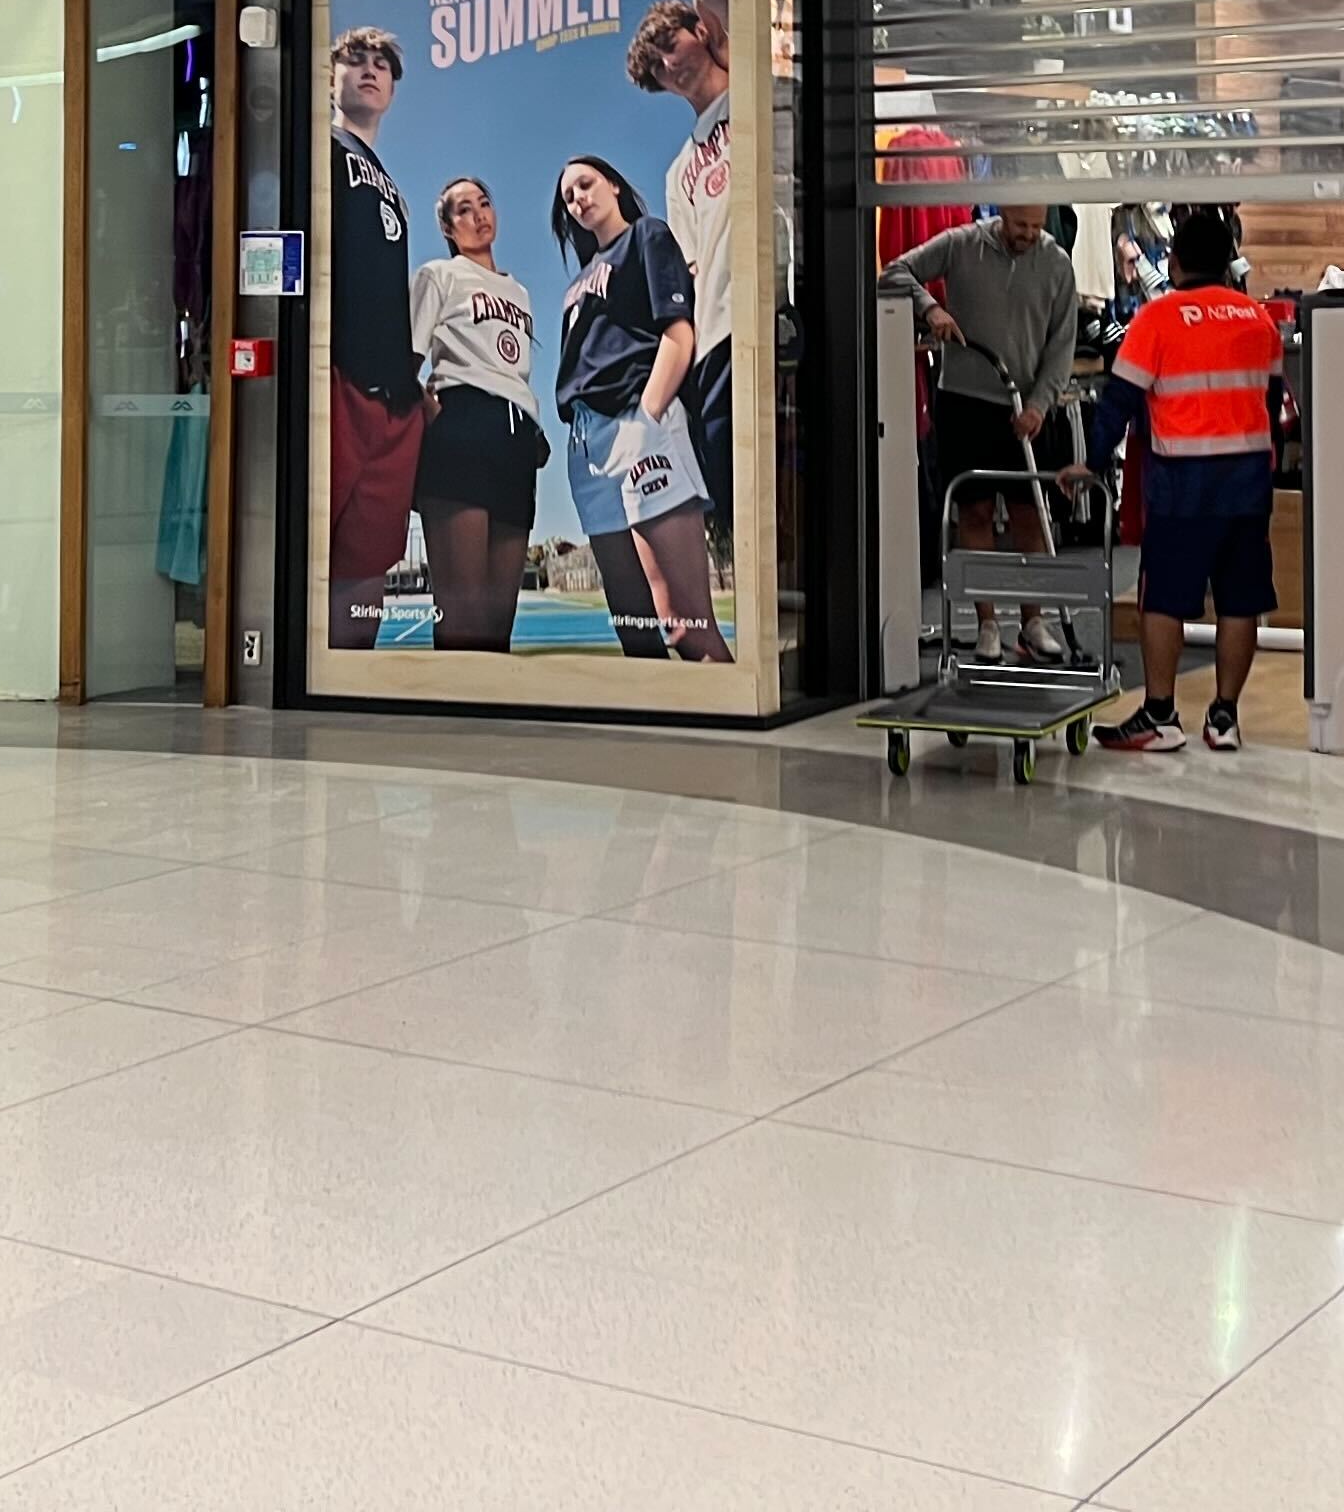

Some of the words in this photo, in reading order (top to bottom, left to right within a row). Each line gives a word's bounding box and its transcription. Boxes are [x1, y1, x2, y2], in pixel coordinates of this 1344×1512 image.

[641, 472, 670, 496] CREW
[350, 604, 388, 622] Stirling
[390, 606, 427, 621] Sports
[608, 614, 709, 631] stirlingsports.co.nz
